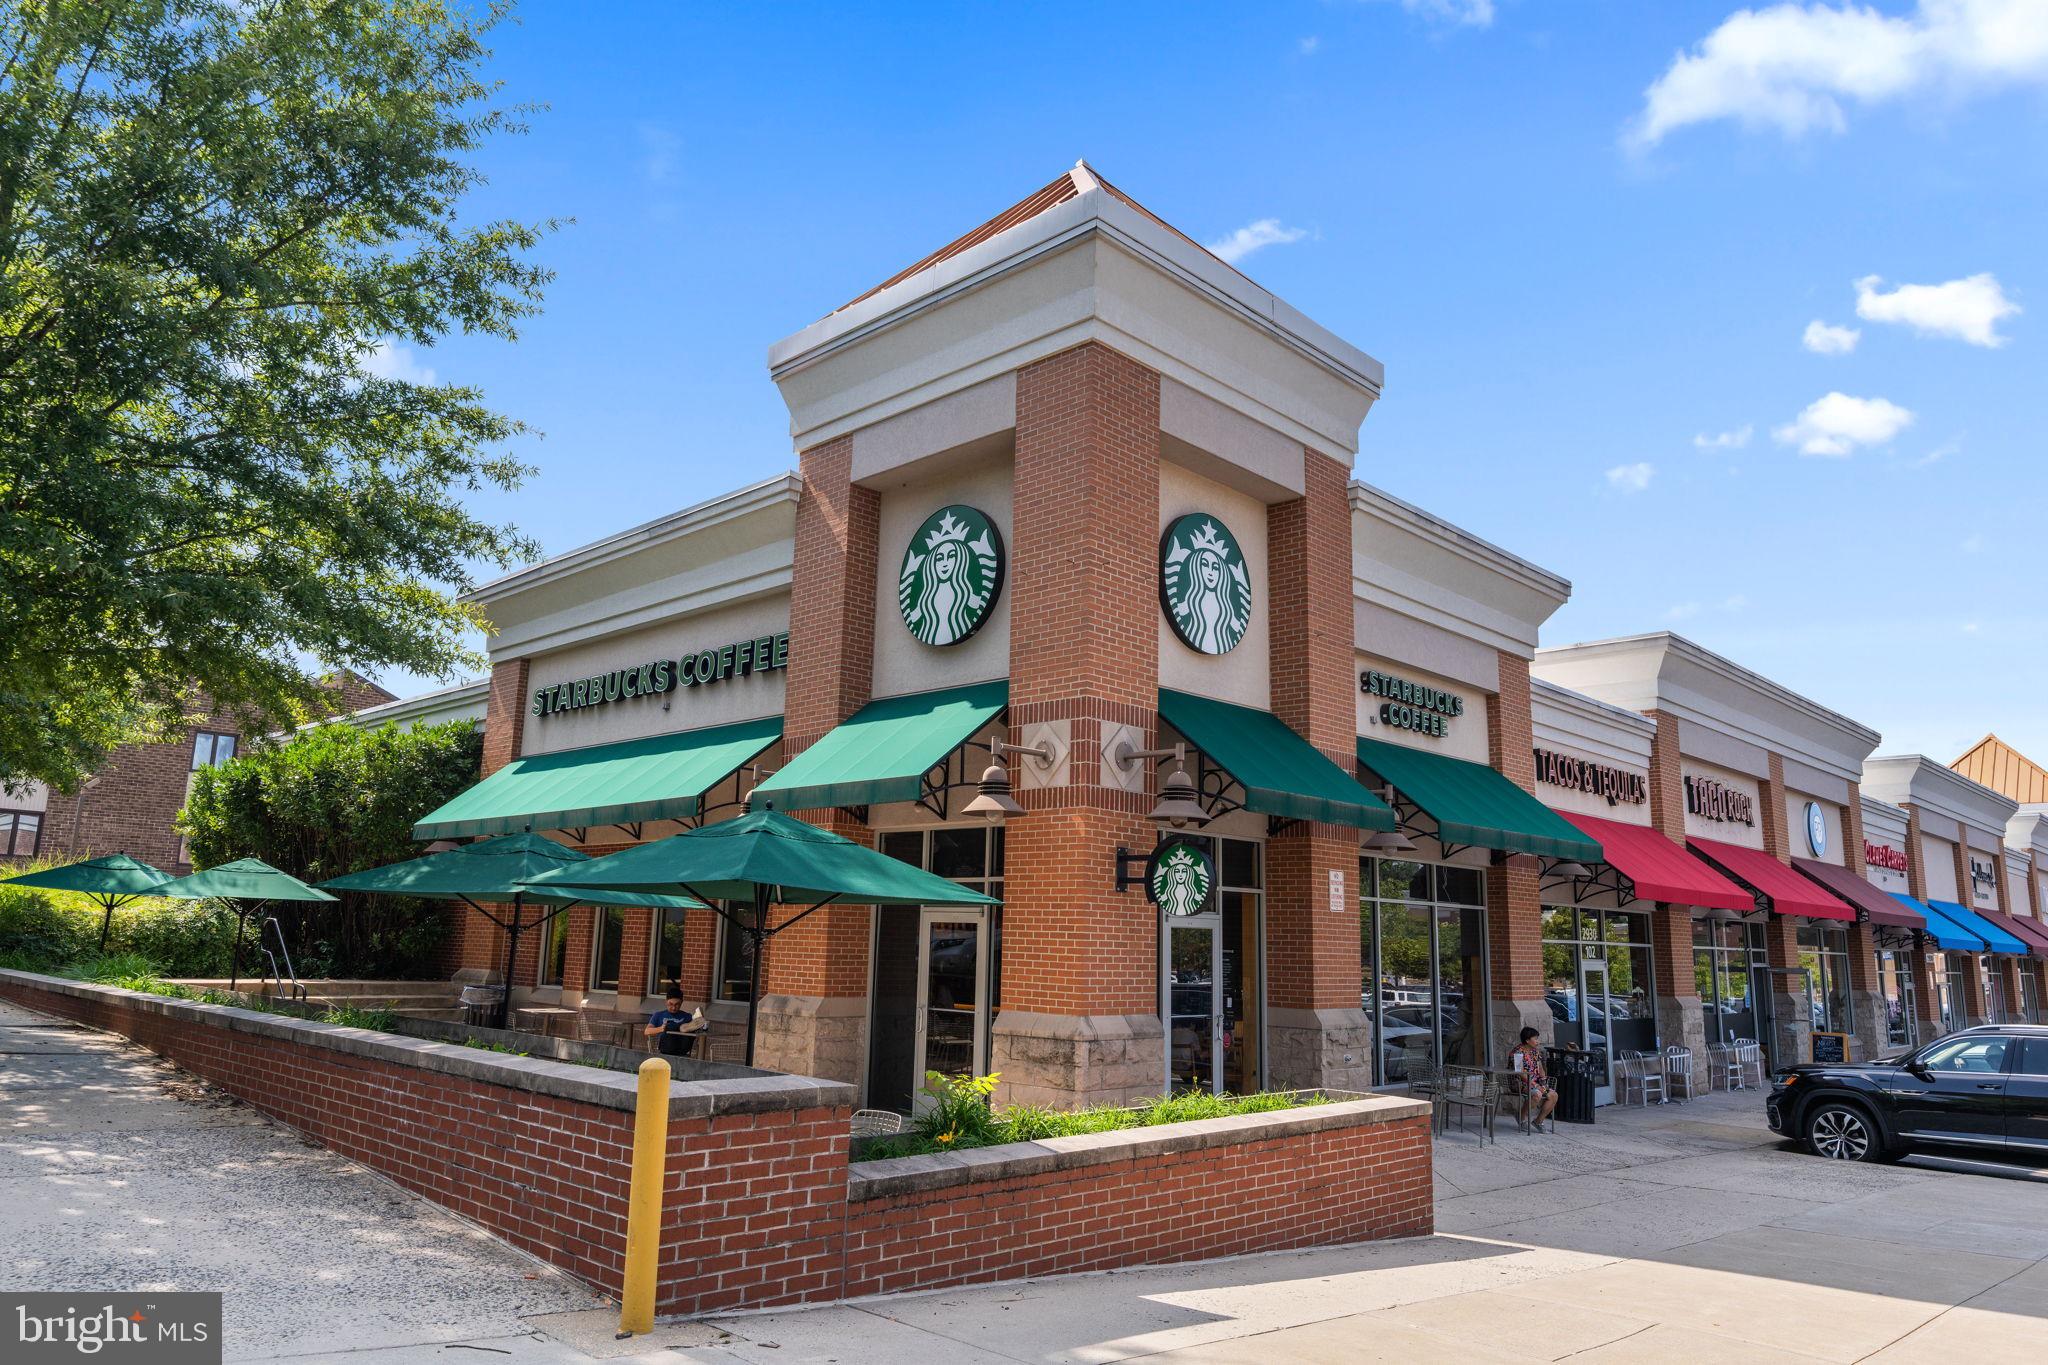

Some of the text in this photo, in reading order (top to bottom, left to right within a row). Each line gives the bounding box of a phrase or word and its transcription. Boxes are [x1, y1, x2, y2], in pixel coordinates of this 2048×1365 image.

[531, 631, 789, 717] STARBUCKS COFFEE
[1364, 670, 1464, 717] STARBUCKS
[1384, 702, 1449, 738] COFFEE
[1536, 749, 1647, 806] TACOS & TEQUILAS
[1687, 776, 1756, 827] TACO ROCK
[1585, 945, 1596, 959] 102
